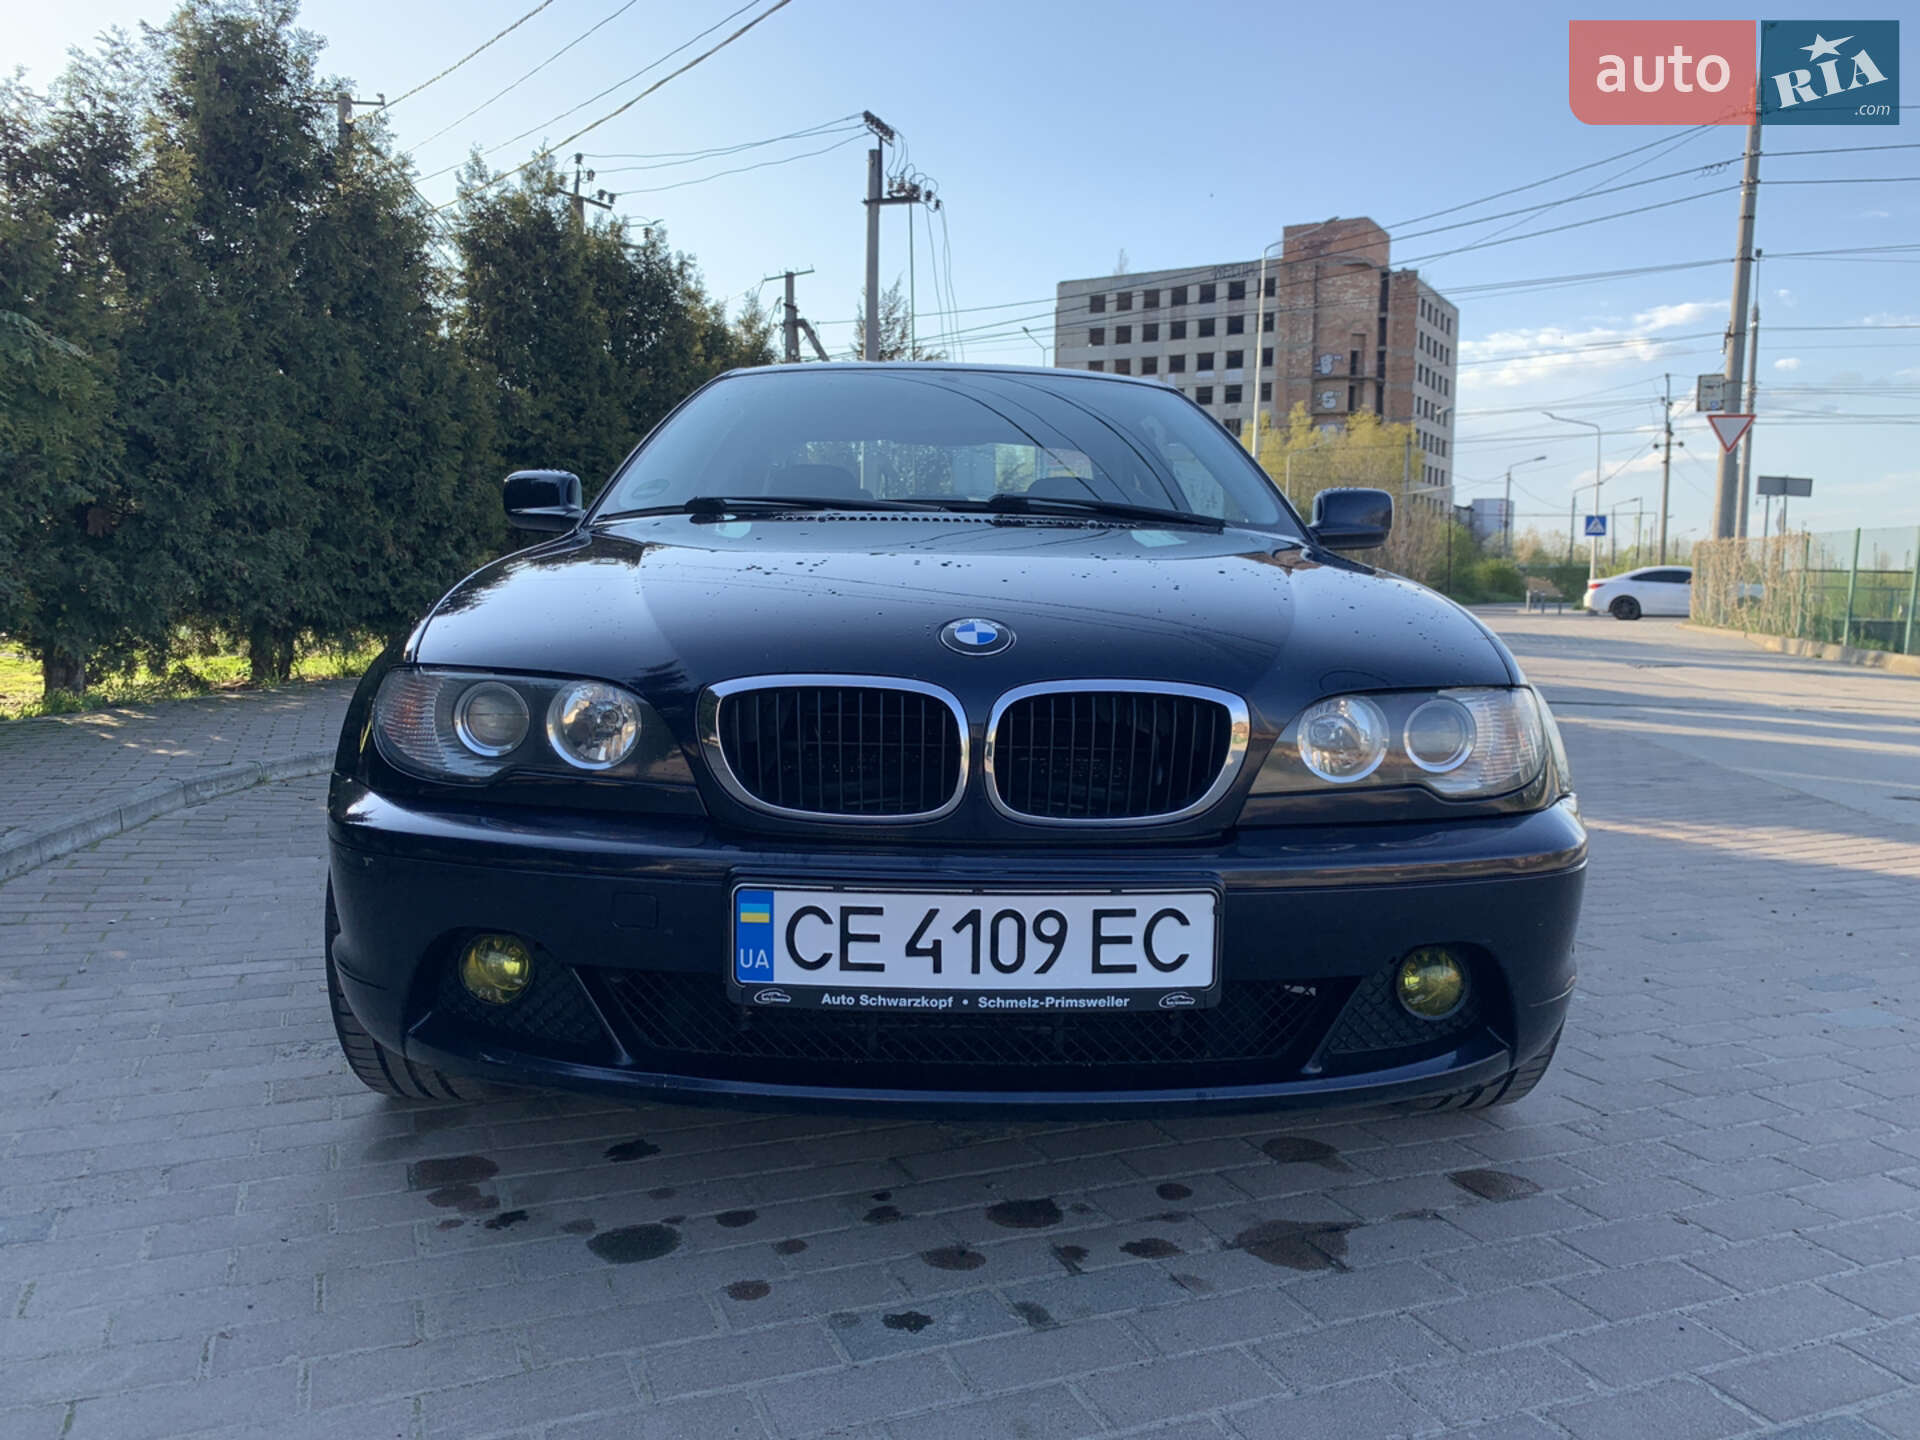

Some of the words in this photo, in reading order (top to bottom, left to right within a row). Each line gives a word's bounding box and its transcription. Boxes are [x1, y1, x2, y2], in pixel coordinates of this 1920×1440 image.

[785, 905, 885, 972] CE
[905, 908, 1069, 974] 4109
[1091, 908, 1191, 974] EC
[739, 949, 770, 969] UA
[821, 993, 855, 1006] Auto
[859, 994, 954, 1010] Schwarzkopf
[978, 996, 1130, 1009] Schmelz-Primsweiler
